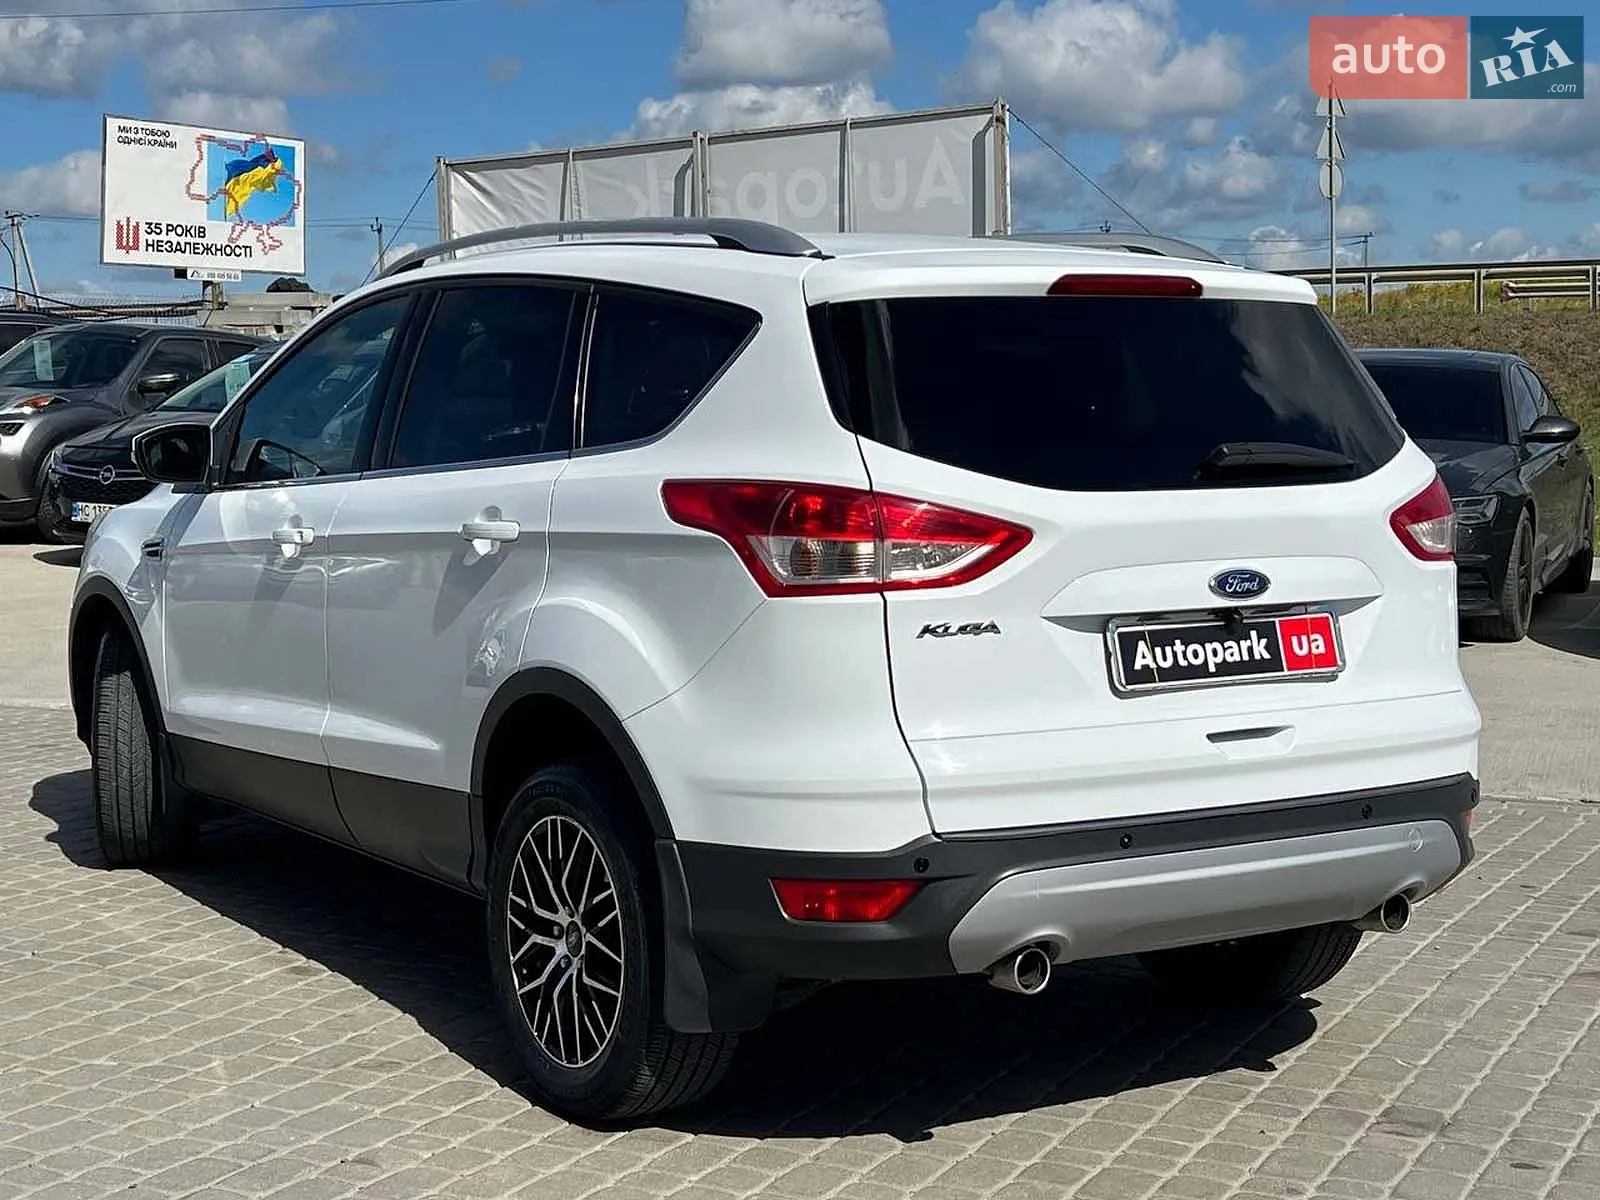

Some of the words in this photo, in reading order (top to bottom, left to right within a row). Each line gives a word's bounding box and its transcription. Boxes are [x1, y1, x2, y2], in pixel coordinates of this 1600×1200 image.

[118, 125, 132, 134] МИ
[140, 127, 171, 138] ТОБОЮ
[147, 138, 177, 150] КРАЇНИ
[144, 222, 163, 236] 35
[165, 223, 207, 239] РОКІВ
[145, 238, 253, 258] НЕЗАЛЕЖНОСТІ
[1226, 574, 1260, 592] Ford
[916, 620, 1001, 639] KUGA
[1133, 630, 1272, 673] Autopark
[1291, 633, 1326, 657] ua
